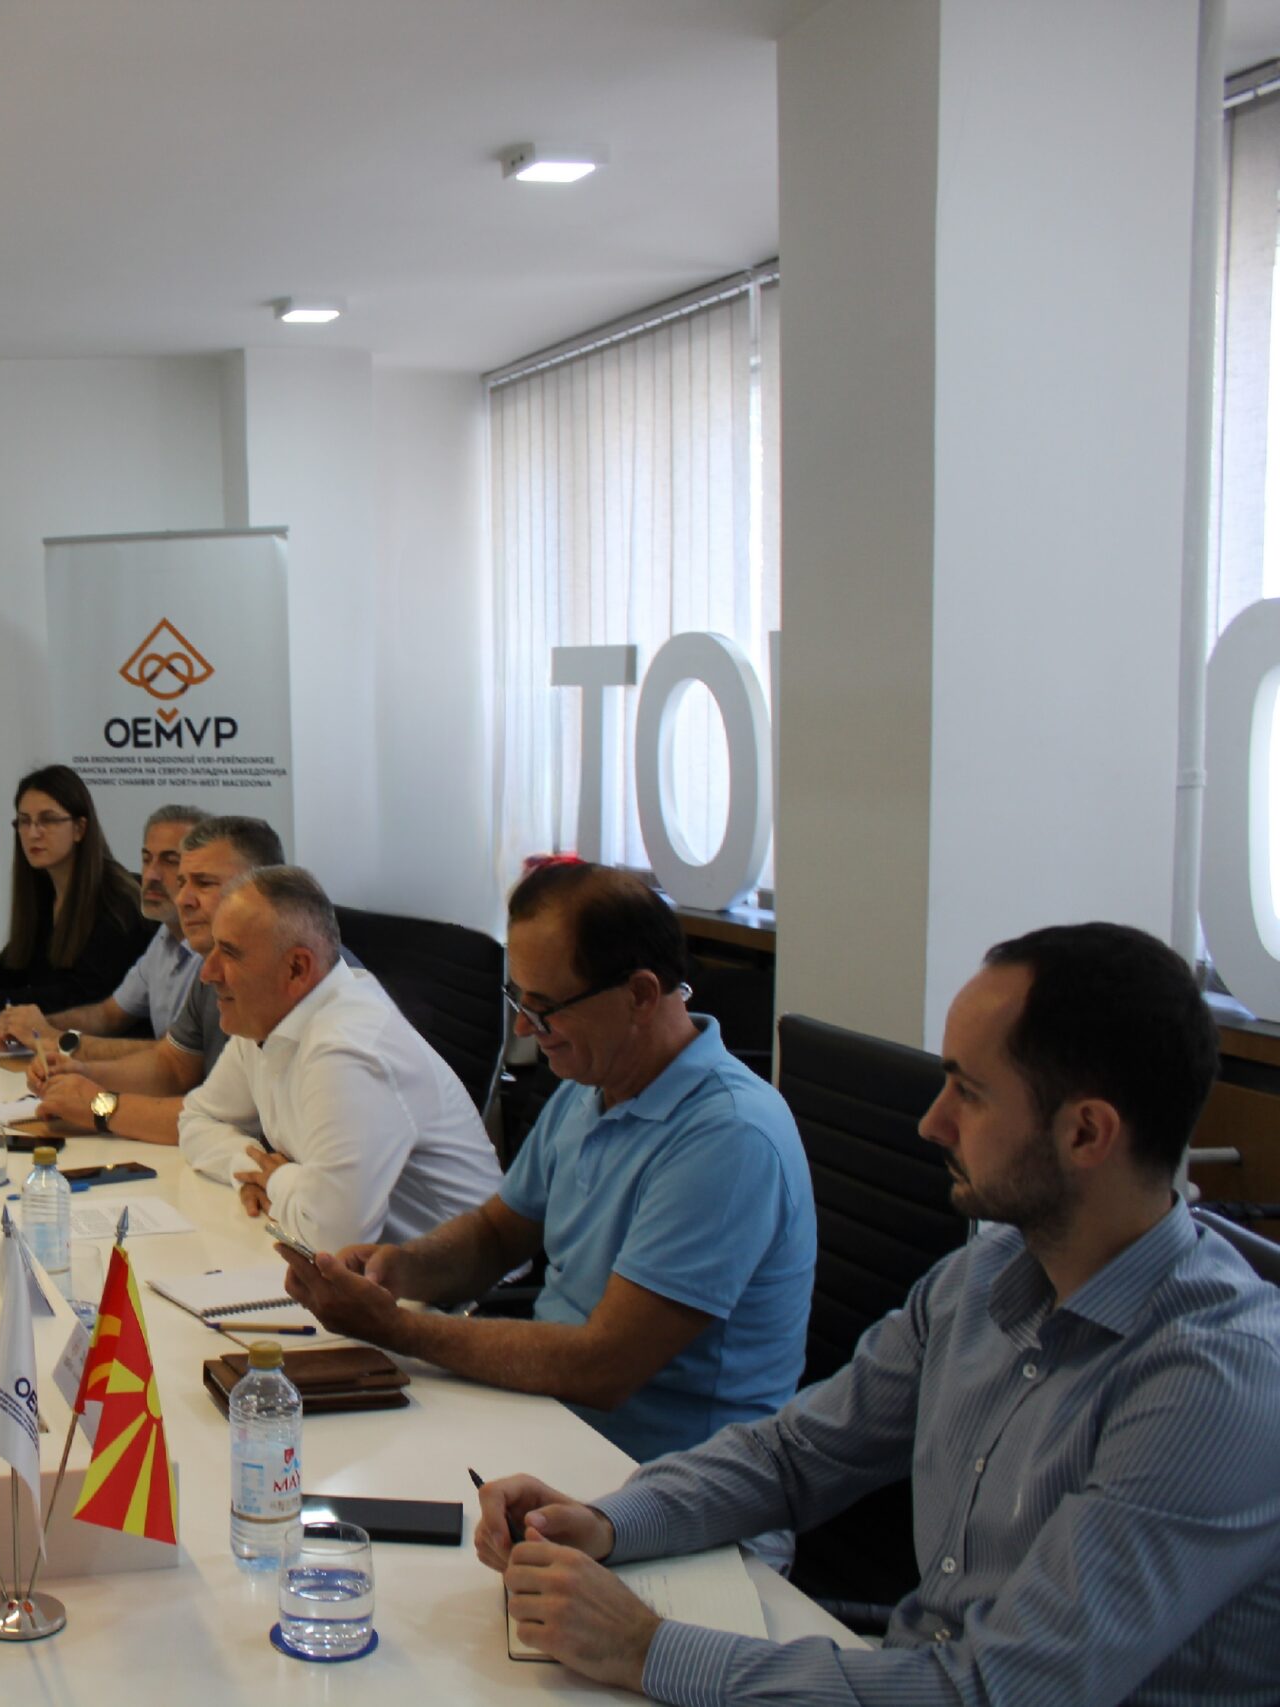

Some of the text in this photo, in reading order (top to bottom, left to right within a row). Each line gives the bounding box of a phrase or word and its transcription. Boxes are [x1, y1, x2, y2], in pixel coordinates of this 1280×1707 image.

[104, 716, 238, 748] OEMVP
[72, 756, 89, 764] ODA
[91, 756, 136, 764] EKONOMIKE
[109, 767, 144, 775] КОМОРА
[145, 767, 156, 775] НА
[118, 778, 155, 786] CHAMBER
[157, 778, 167, 786] OF
[222, 779, 272, 787] MACEDONIA
